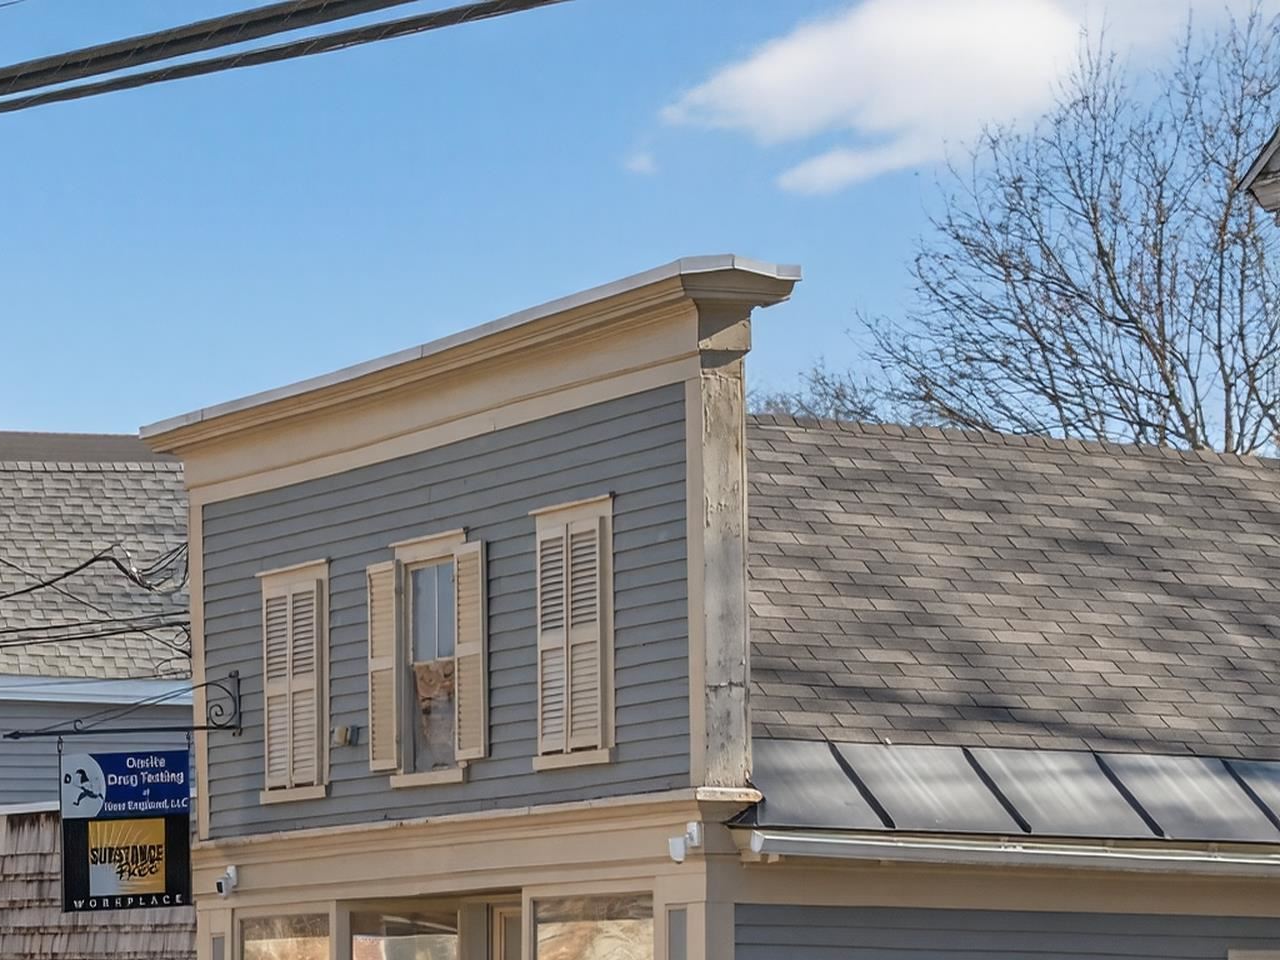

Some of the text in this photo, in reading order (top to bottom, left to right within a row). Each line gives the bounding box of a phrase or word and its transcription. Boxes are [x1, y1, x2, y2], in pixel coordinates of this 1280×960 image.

[107, 769, 184, 787] Drug Testing
[90, 844, 163, 866] SUBSTANCE
[73, 893, 183, 909] WORKPLACE
